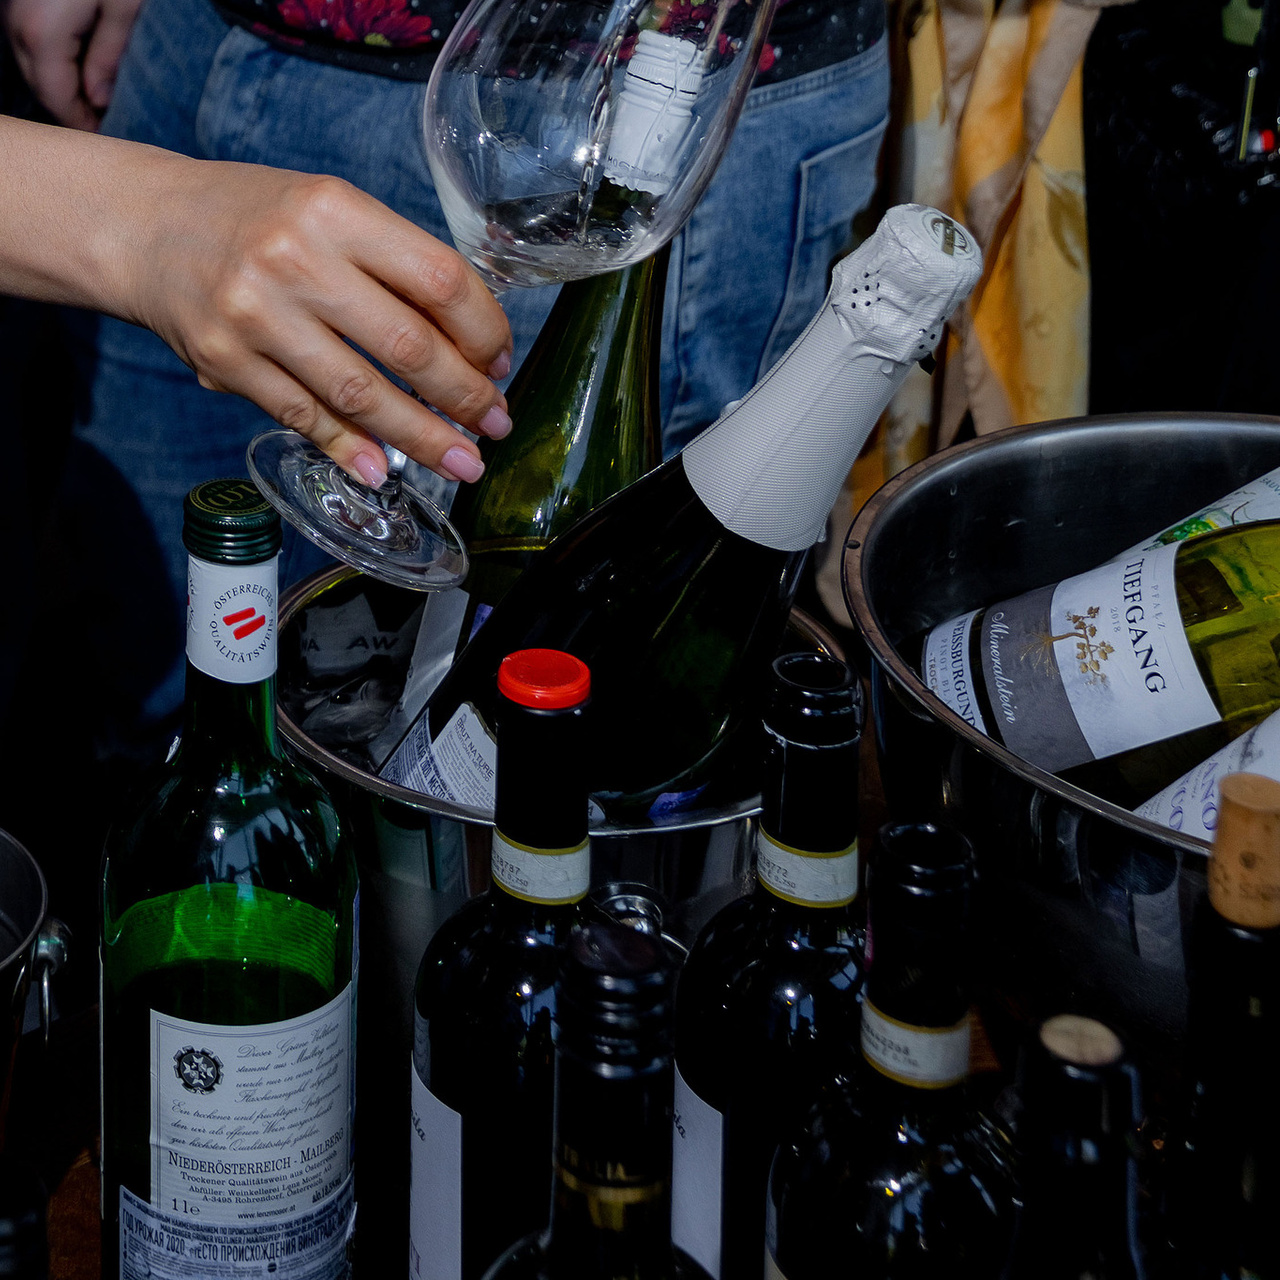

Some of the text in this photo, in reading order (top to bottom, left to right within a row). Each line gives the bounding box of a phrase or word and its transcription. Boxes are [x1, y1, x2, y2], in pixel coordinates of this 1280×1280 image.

[1110, 606, 1121, 633] 2018
[1151, 584, 1166, 630] PFALZ
[1123, 558, 1167, 693] TIEFGANG
[209, 617, 274, 664] QUALITÄTSWEIN
[940, 638, 948, 672] PINOT
[990, 612, 1017, 724] Mineralstein
[456, 718, 495, 779] BRUT NATURE
[472, 758, 490, 782] METHOD
[237, 1044, 272, 1058] Dieser
[236, 1063, 271, 1073] stammt
[236, 1077, 263, 1088] wurde
[172, 1099, 191, 1116] Ein
[193, 1109, 231, 1121] trockener
[233, 1110, 254, 1121] und
[171, 1119, 188, 1131] den
[191, 1125, 206, 1134] wir
[208, 1124, 224, 1135] als
[225, 1126, 260, 1140] offenen
[262, 1118, 286, 1135] Wein
[168, 1127, 345, 1175] NIEDERÖSTERREICH MAILBERG
[180, 1150, 338, 1186] Trockener Qualitätswein aus Österreich
[189, 1185, 225, 1196] Abfüller:
[228, 1185, 280, 1196] Weinkellerei
[282, 1181, 300, 1191] Lenz
[302, 1173, 322, 1185] Moser
[203, 1195, 232, 1203] A-3495
[287, 1179, 323, 1197] Österreich
[237, 1204, 296, 1219] www.lenzmoser.at
[122, 1208, 134, 1233] ГОД
[134, 1218, 165, 1248] УРОЖАЯ
[221, 1237, 296, 1262] ПРОИСХОЖДЕНИЯ
